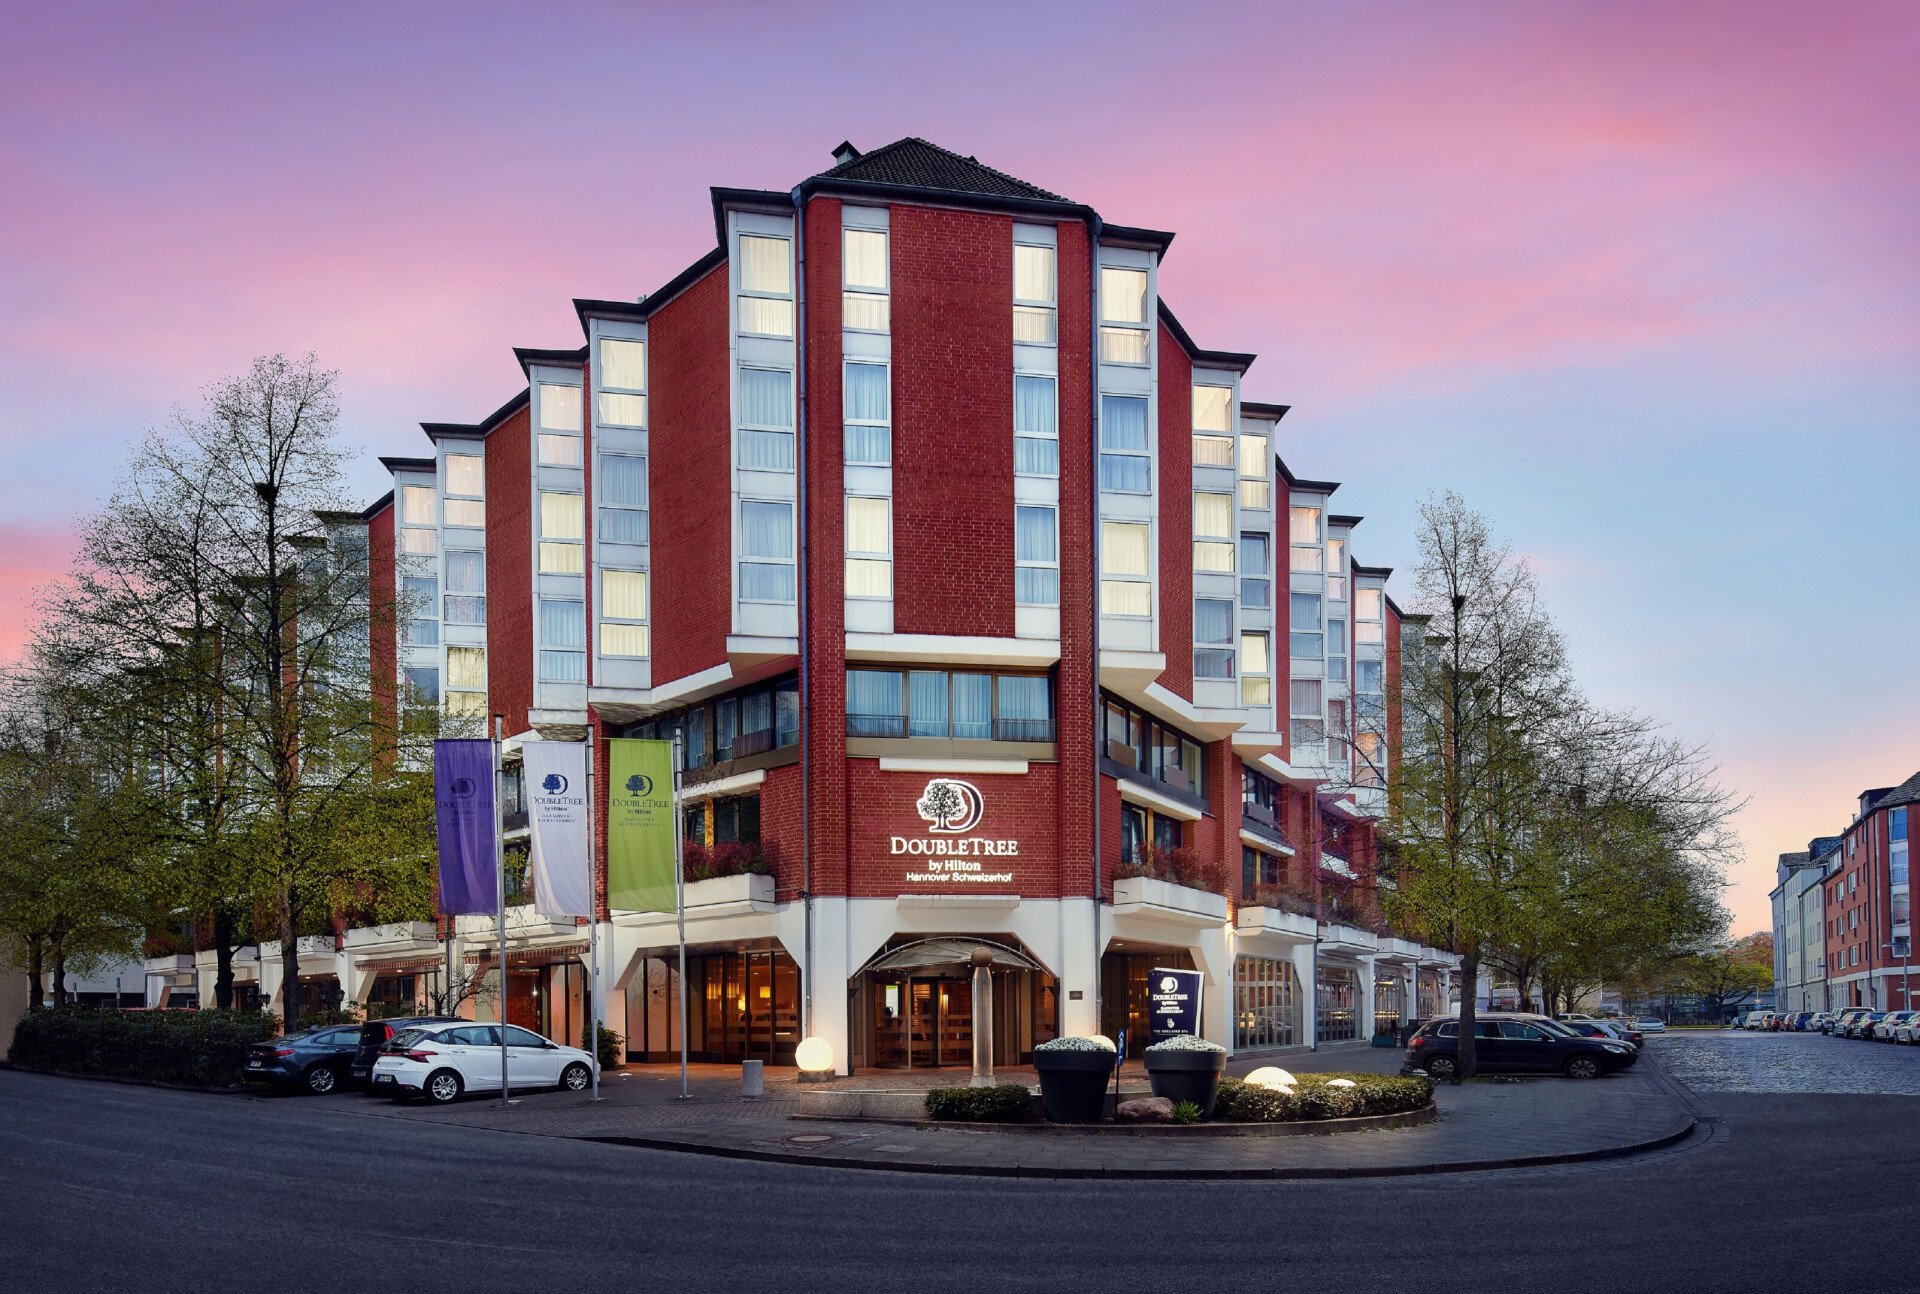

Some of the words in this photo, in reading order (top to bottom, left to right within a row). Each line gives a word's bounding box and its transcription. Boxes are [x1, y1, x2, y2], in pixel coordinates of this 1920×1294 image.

[612, 798, 670, 808] DOUBLETREE
[890, 836, 1018, 856] DOUBLETREE
[928, 860, 942, 873] by
[944, 860, 981, 871] Hilton
[906, 872, 950, 882] Hannover
[952, 872, 1013, 883] Schweizerhof
